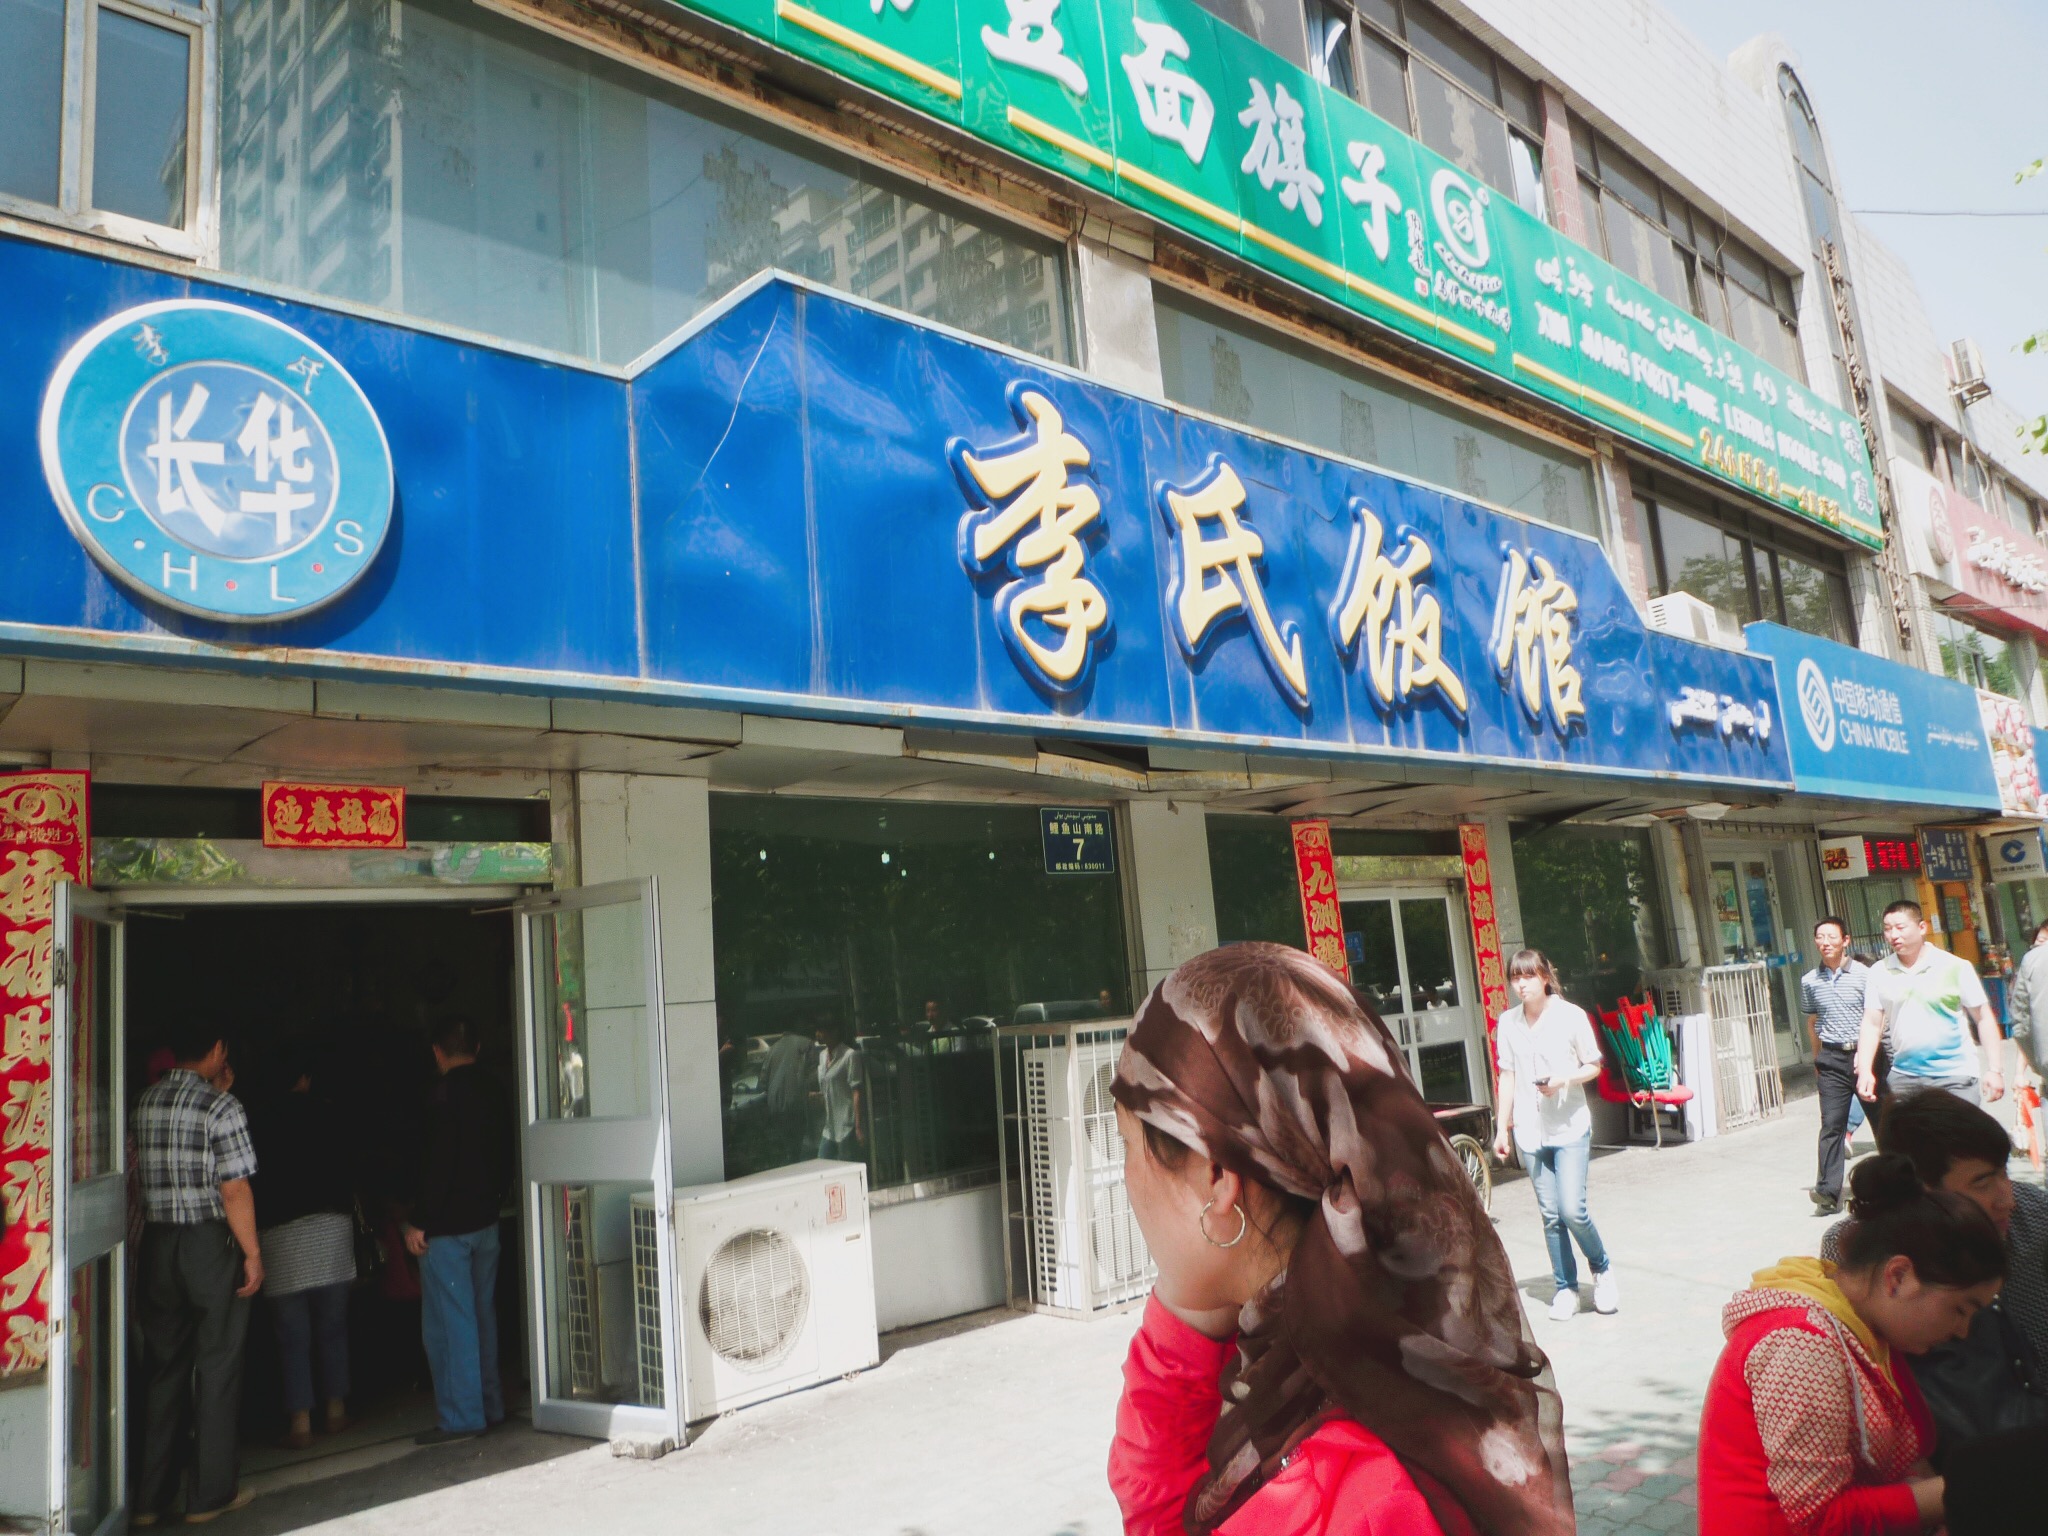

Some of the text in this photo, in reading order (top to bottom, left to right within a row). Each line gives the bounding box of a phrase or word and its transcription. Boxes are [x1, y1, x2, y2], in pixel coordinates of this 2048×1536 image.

[866, 0, 1402, 262] 豆面旗子
[146, 381, 316, 546] 长华
[955, 385, 1590, 732] 李氏饭馆
[1831, 675, 1904, 726] 中国移动通信
[1839, 718, 1874, 748] CHINA
[1872, 726, 1911, 755] MOBILE
[1072, 838, 1085, 861] 7
[1304, 860, 1346, 978] 九洲鸿
